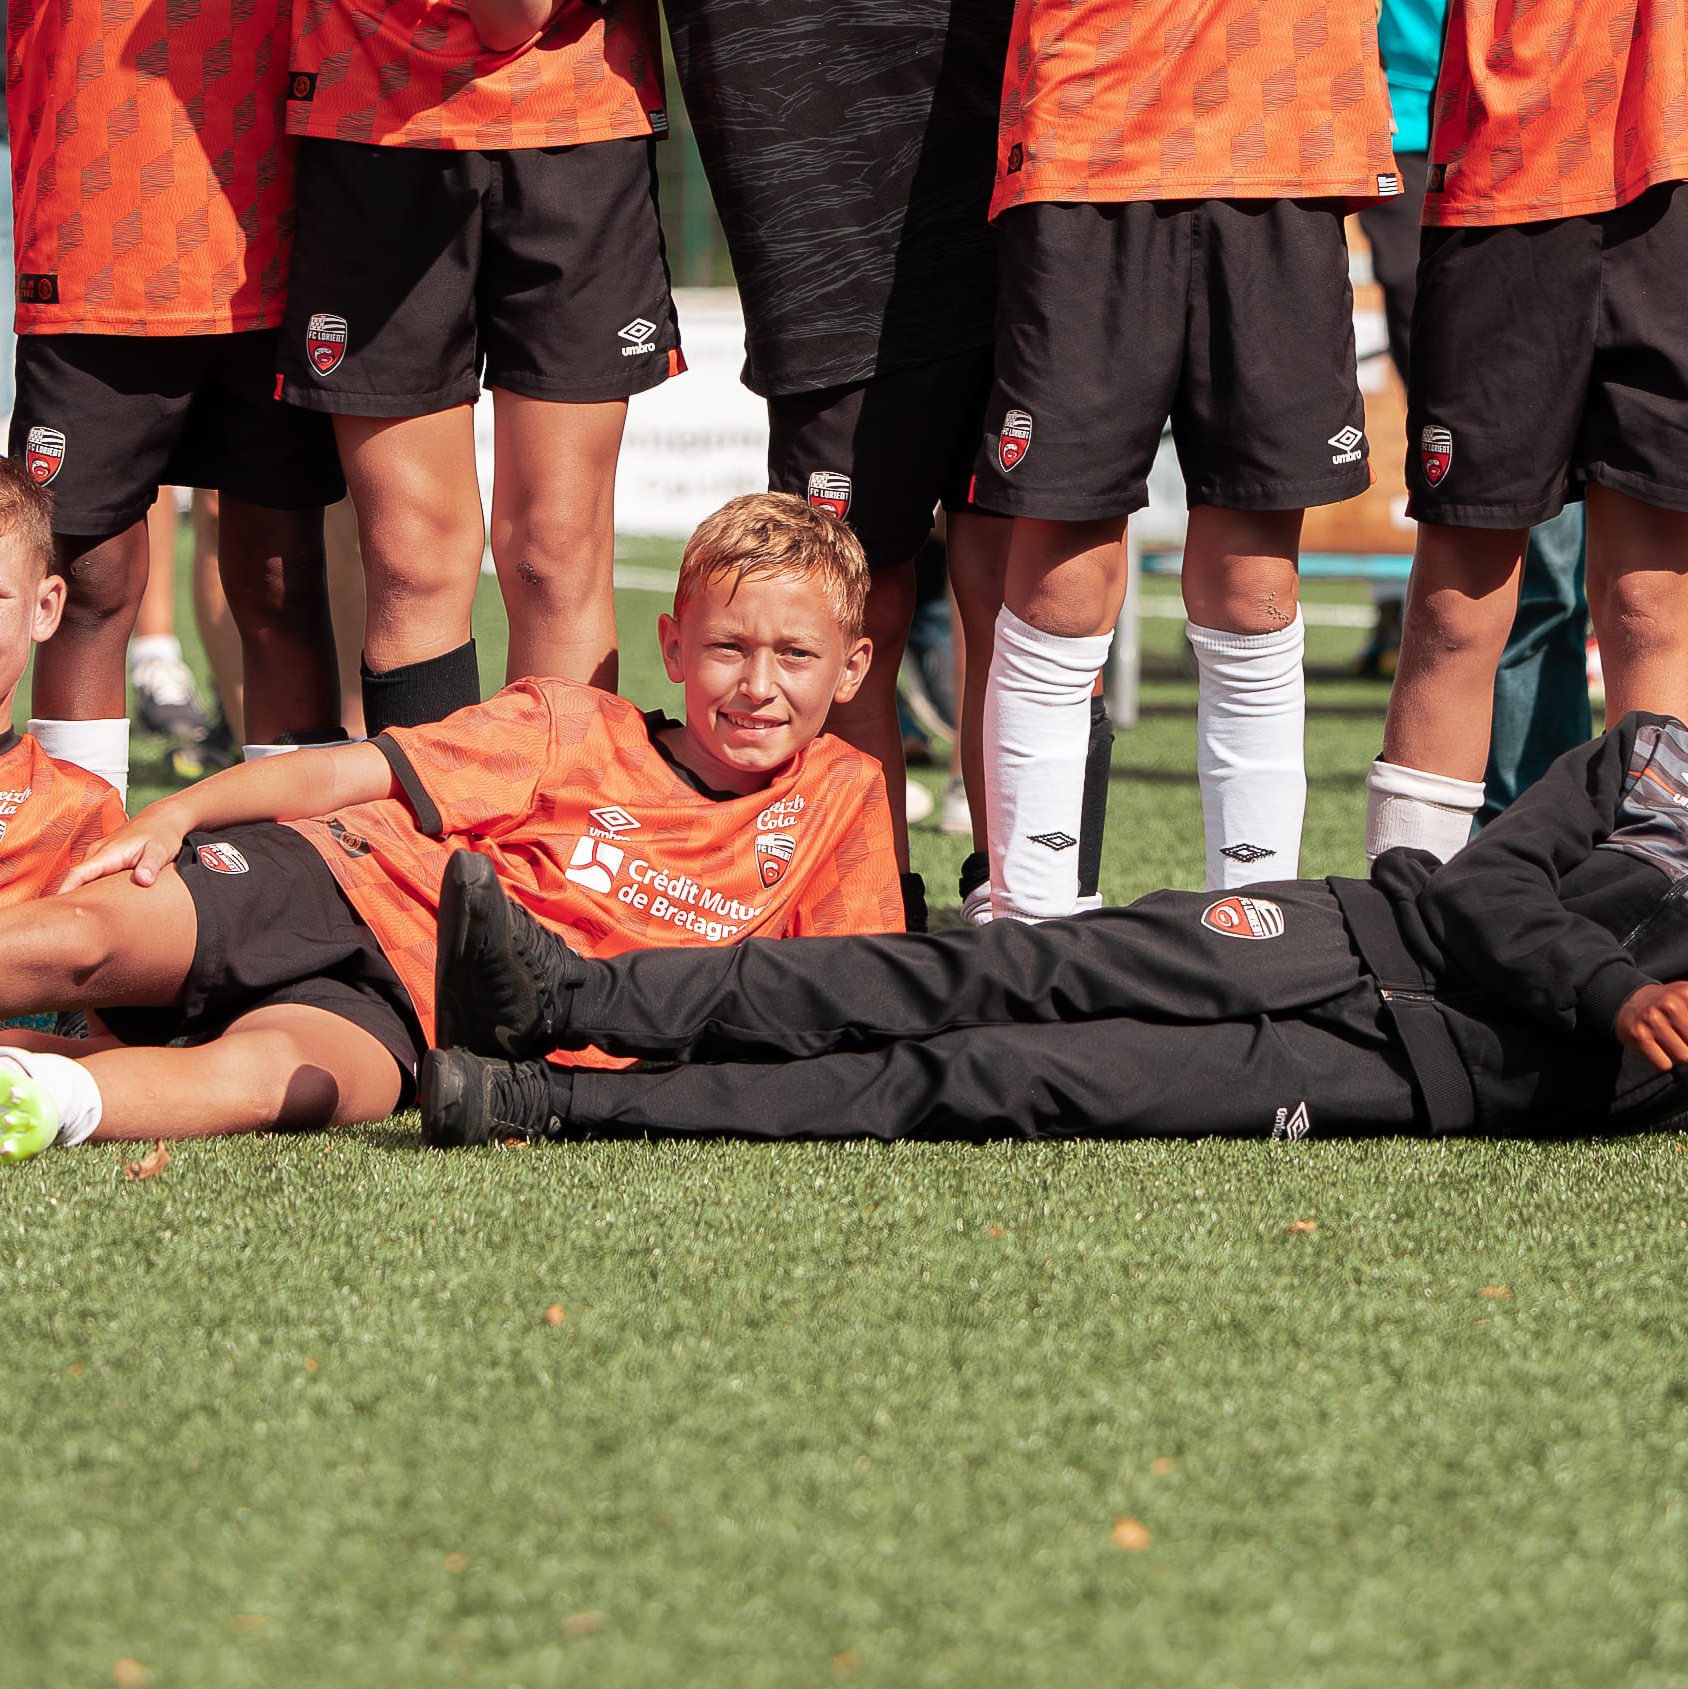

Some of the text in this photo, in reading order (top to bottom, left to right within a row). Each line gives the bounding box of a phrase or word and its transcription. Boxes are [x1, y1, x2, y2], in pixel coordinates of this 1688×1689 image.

[309, 331, 345, 343] FC LORIENT
[622, 343, 655, 357] umbro
[1333, 450, 1362, 465] umbro
[810, 489, 848, 501] FC LORIENT
[757, 810, 797, 831] Cola
[629, 859, 699, 905] Crédit
[618, 884, 649, 909] de
